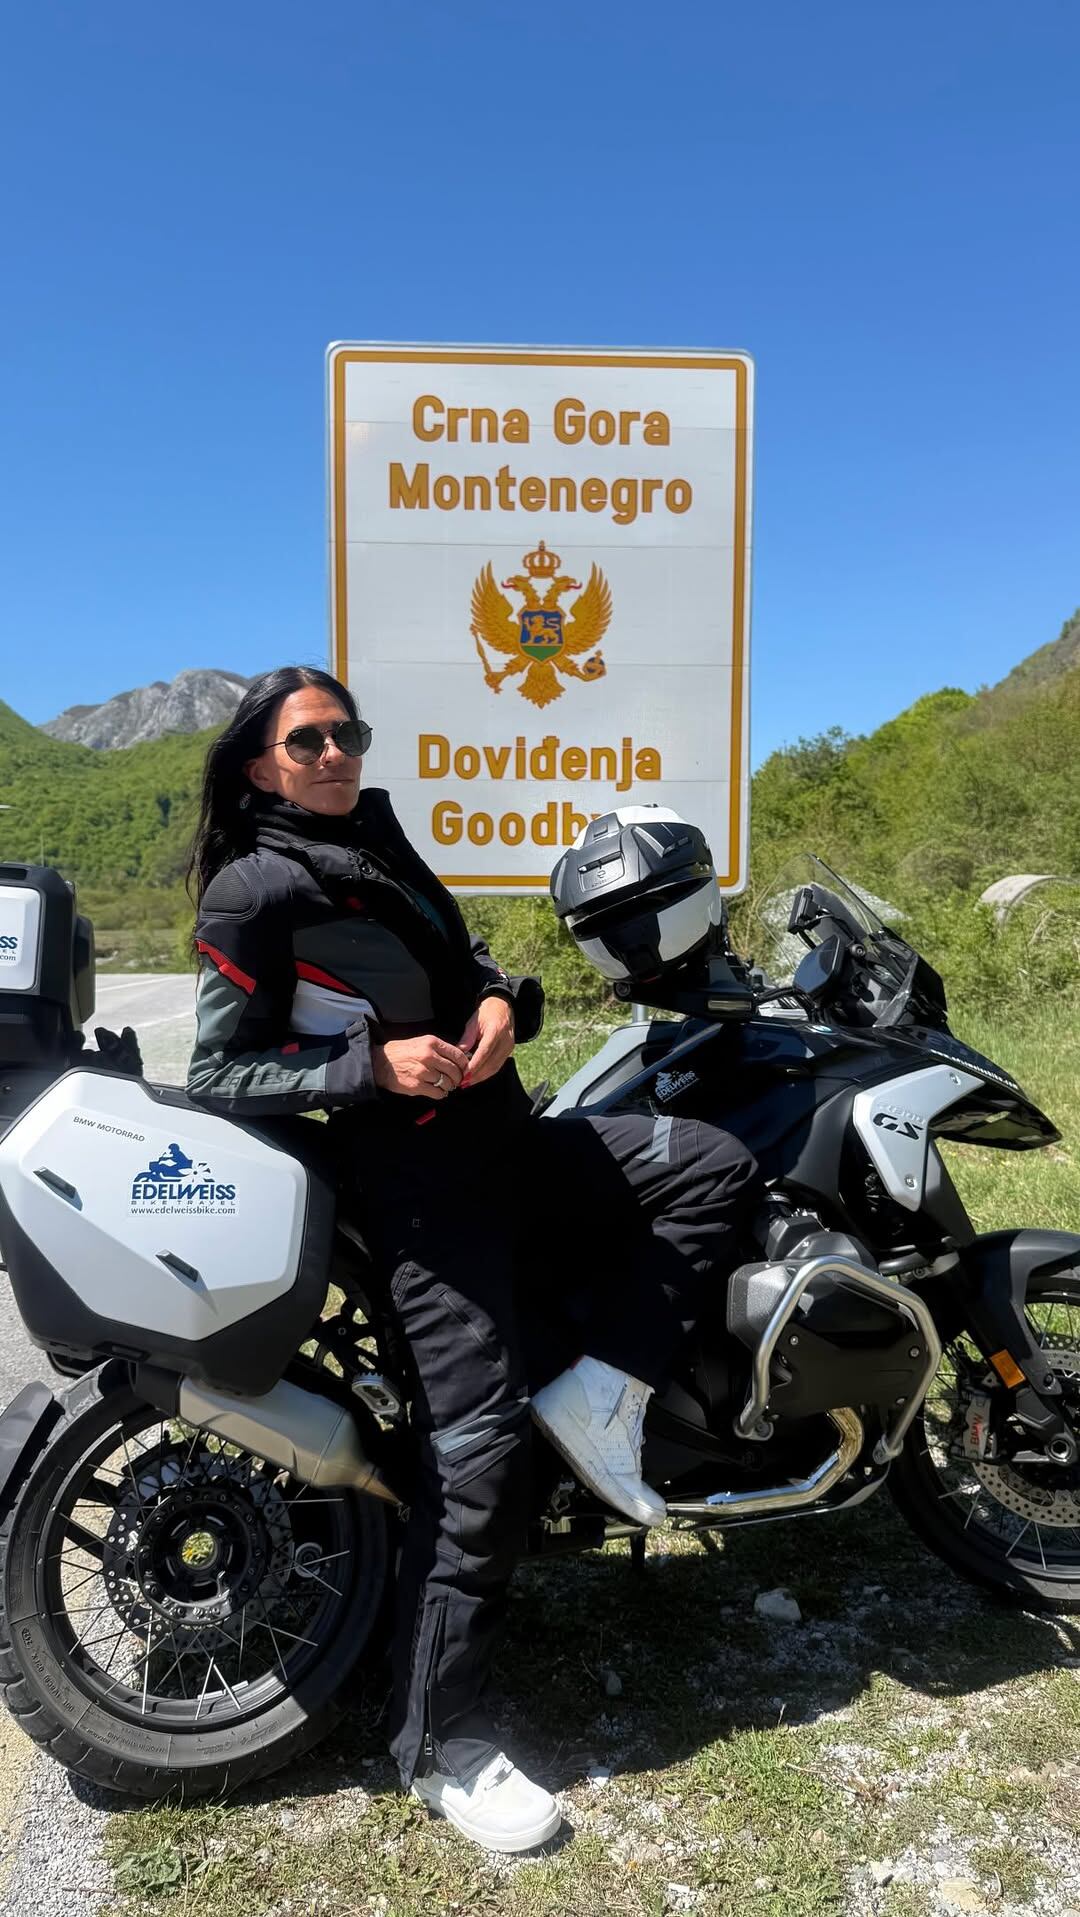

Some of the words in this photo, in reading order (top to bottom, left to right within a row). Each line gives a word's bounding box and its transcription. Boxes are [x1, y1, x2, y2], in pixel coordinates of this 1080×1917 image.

[412, 394, 530, 443] Crna
[553, 397, 671, 446] Gora
[388, 462, 693, 525] Montenegro
[418, 734, 662, 792] Doviđenja
[431, 800, 602, 847] Goodb
[73, 1116, 96, 1127] BMW
[96, 1123, 146, 1142] MOTORRAD
[872, 1112, 924, 1141] GS
[130, 1205, 237, 1215] www.edelweissbike.com
[131, 1183, 237, 1200] EDELWEISS
